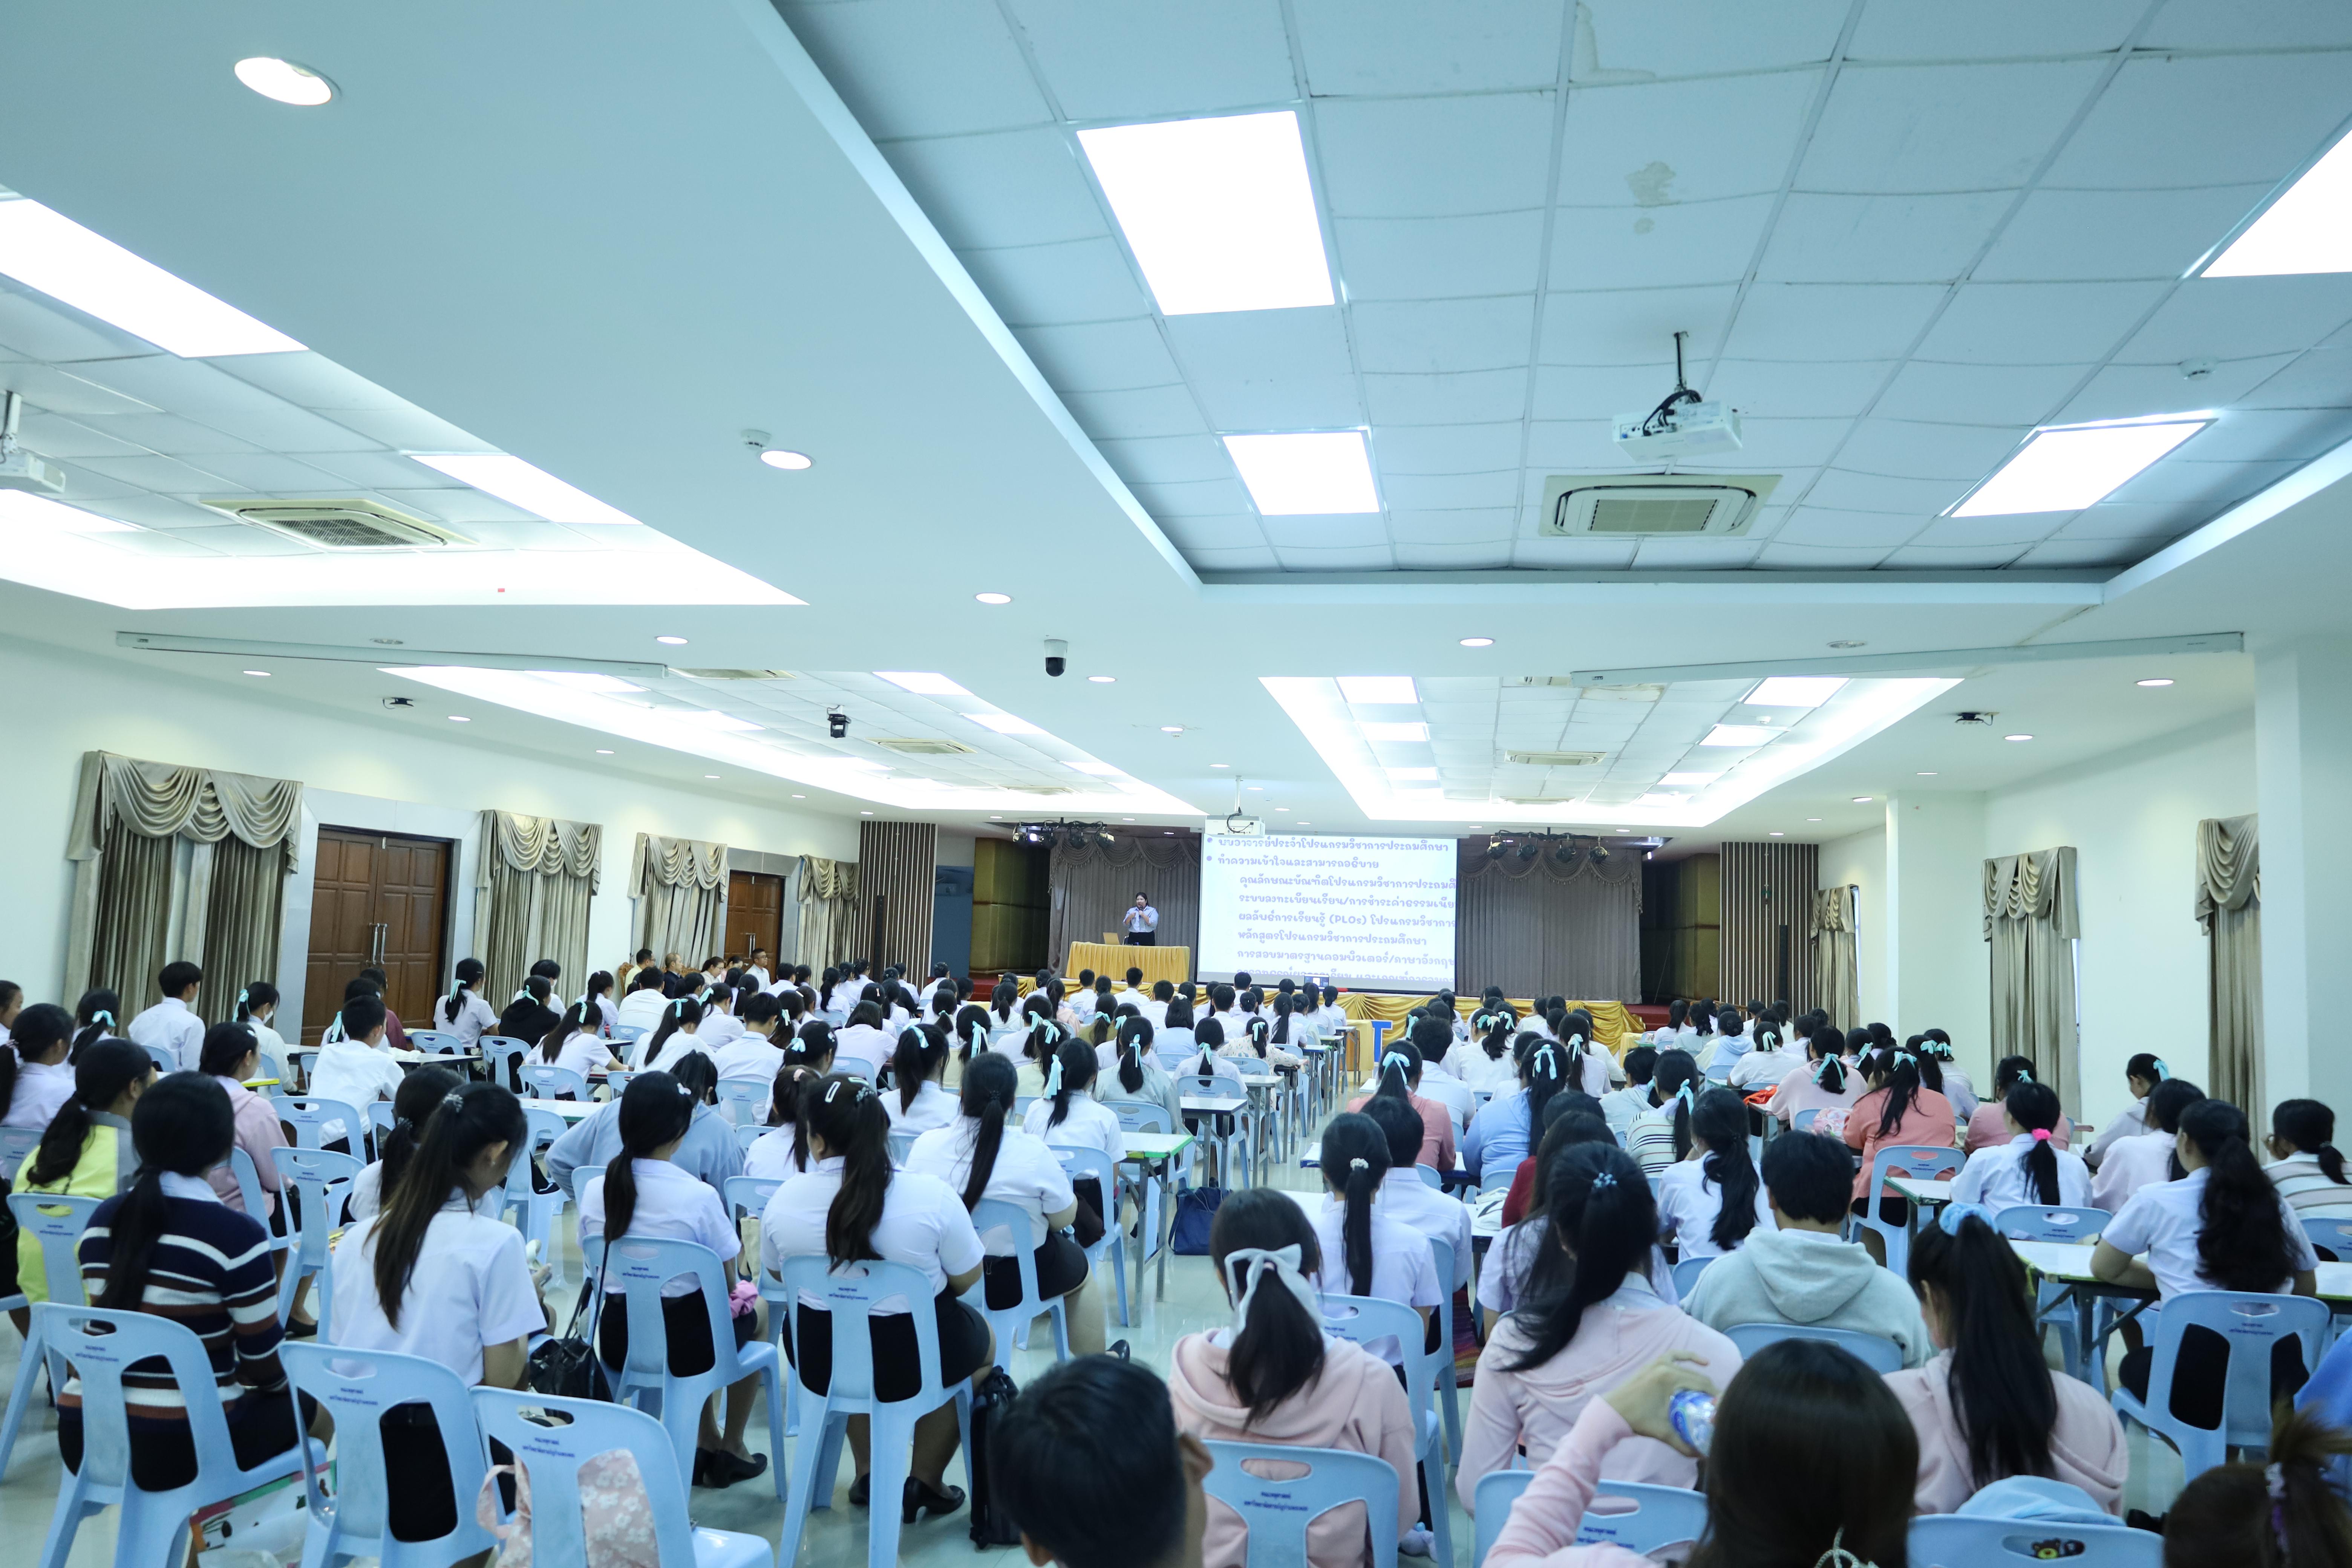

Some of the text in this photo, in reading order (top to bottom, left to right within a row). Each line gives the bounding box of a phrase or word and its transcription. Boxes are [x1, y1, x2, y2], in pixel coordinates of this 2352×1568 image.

[1217, 853, 1379, 868] ทำความเข้าใจและสามารถอธิบาย
[1239, 892, 1455, 908] ระบบลงทะเบียนเรียน/การชำระค่าธรรมเนีย
[1239, 910, 1325, 927] ผลลัพธ์การเรียนรู้
[1329, 914, 1367, 925] (PLOs)
[1238, 928, 1427, 945] หลักสูตรโปรแกรมวิชาการประถมศึกษา
